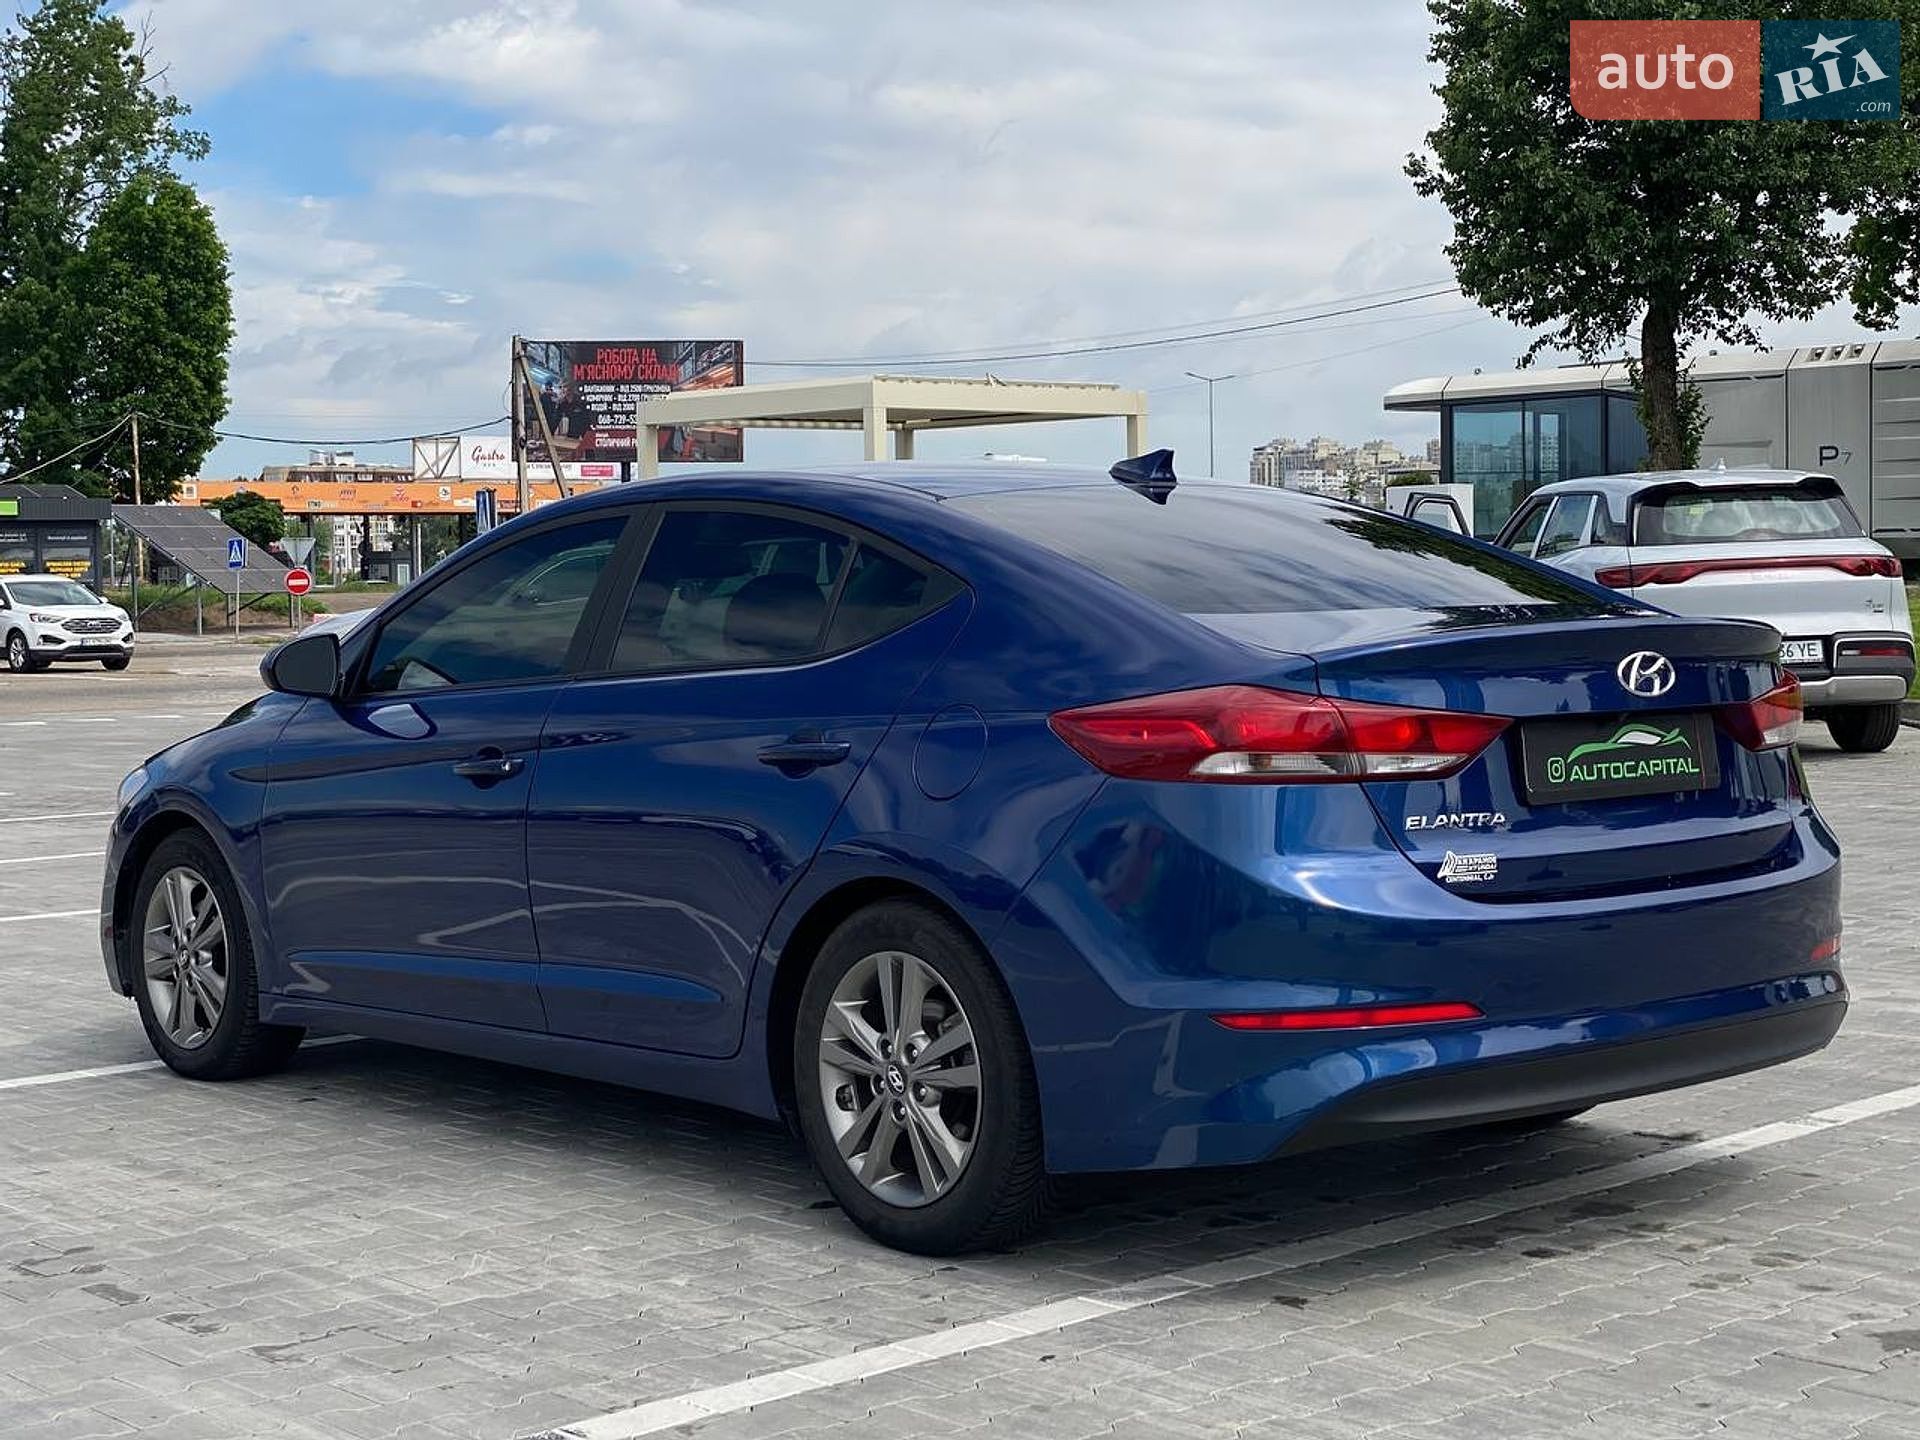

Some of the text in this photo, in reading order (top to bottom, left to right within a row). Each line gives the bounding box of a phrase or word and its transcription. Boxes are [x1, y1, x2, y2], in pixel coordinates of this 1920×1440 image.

[597, 347, 657, 364] РОБОТА НА
[1797, 642, 1818, 657] YE
[1569, 757, 1700, 782] AUTOCAPITAL
[1404, 813, 1506, 831] ELANTRA
